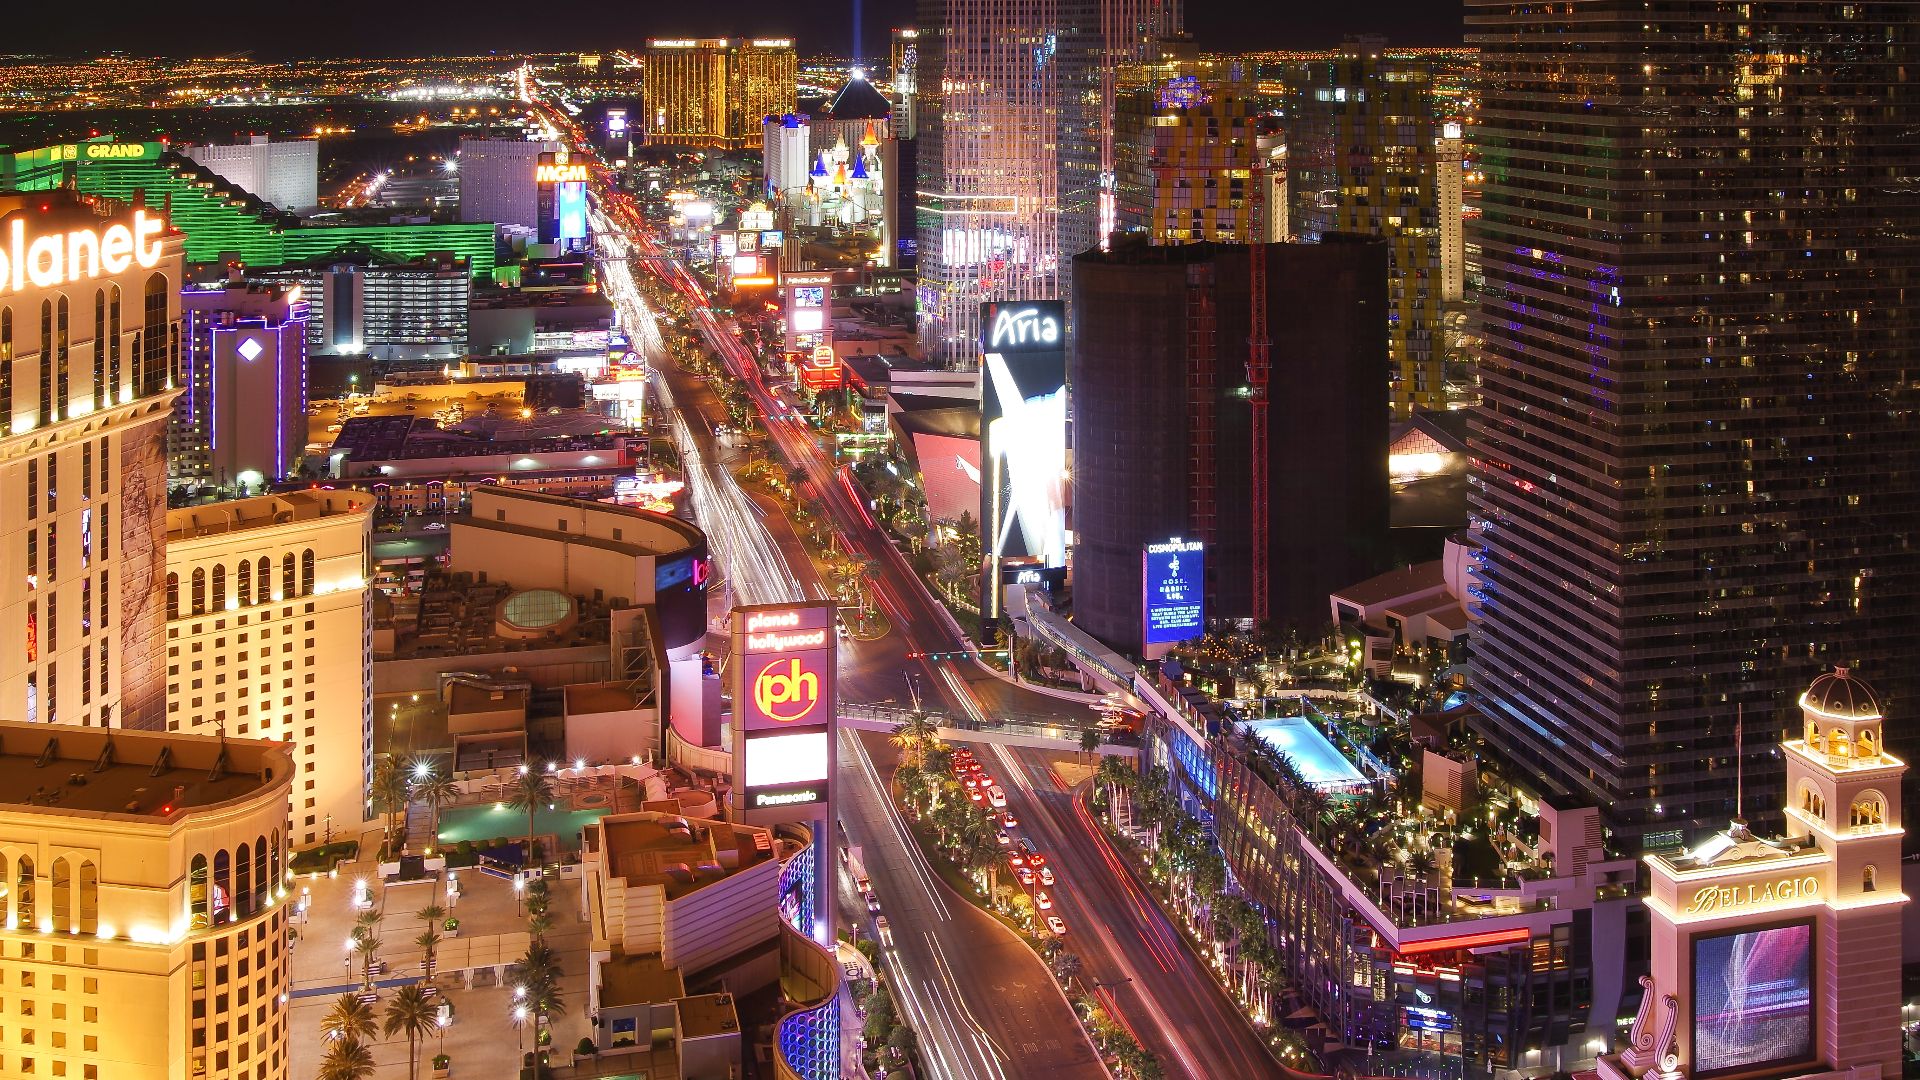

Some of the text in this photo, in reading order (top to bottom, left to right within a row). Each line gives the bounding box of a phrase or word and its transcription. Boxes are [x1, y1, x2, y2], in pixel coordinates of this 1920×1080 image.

[87, 144, 145, 158] GRAND
[536, 165, 588, 182] MGM
[0, 209, 163, 294] lanet
[1149, 542, 1203, 553] COSMOPOLITAN
[748, 612, 799, 633] planet
[748, 630, 825, 652] hollywood
[762, 658, 818, 717] ph
[756, 790, 817, 806] Panasonic
[1687, 876, 1819, 914] BELLAGIO
